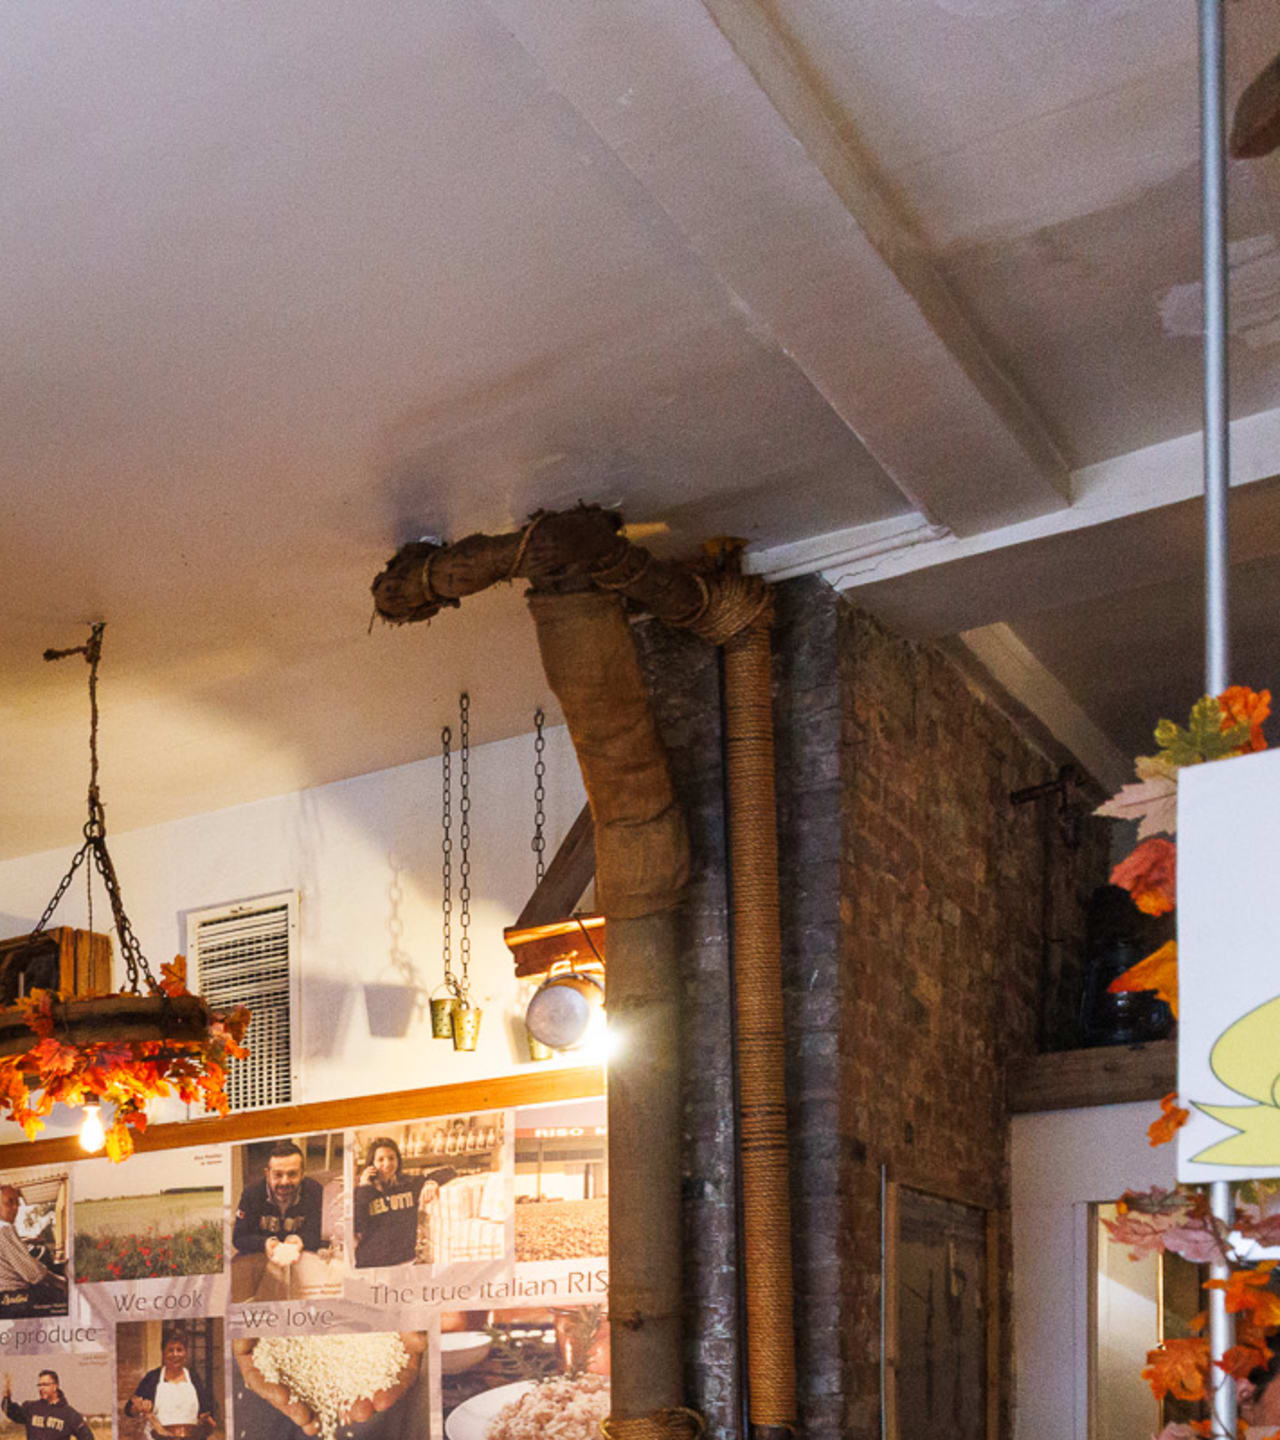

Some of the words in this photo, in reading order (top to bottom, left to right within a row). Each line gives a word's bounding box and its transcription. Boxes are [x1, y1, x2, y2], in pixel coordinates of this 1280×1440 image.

[113, 1293, 146, 1312] We
[152, 1290, 203, 1311] cook
[370, 1284, 414, 1304] The
[421, 1284, 472, 1302] true
[479, 1277, 557, 1300] italian
[241, 1310, 280, 1329] We
[286, 1308, 335, 1327] love
[15, 1325, 98, 1350] produce
